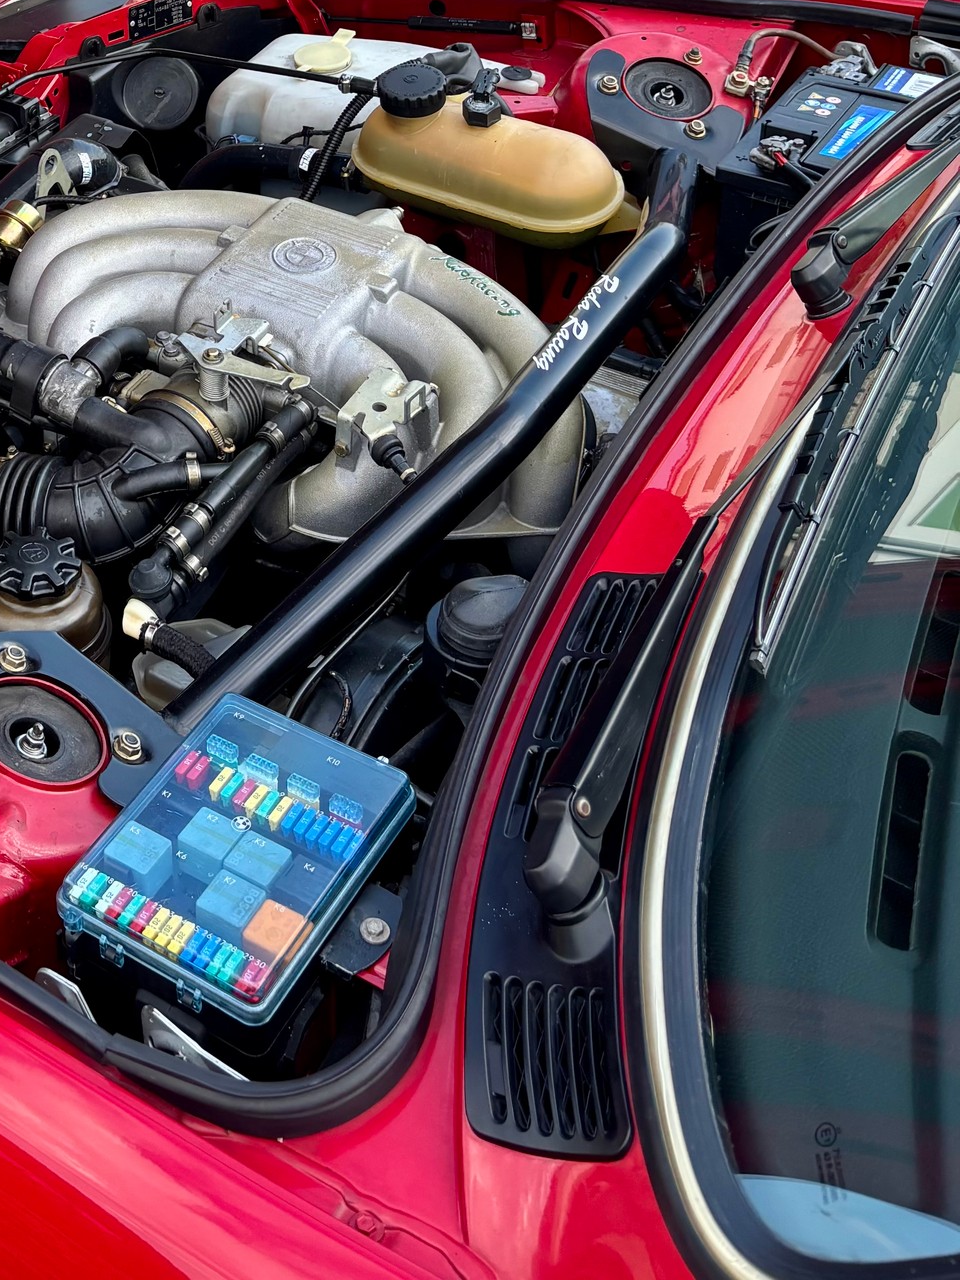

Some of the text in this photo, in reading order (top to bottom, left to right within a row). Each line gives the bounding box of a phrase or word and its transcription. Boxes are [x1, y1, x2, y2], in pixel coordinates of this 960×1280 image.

[326, 756, 341, 766] K10
[161, 790, 172, 799] K1
[207, 813, 219, 823] K2
[129, 825, 141, 835] K5
[254, 838, 266, 847] K3
[176, 850, 187, 860] K6
[304, 863, 316, 872] K4
[223, 875, 236, 885] K7
